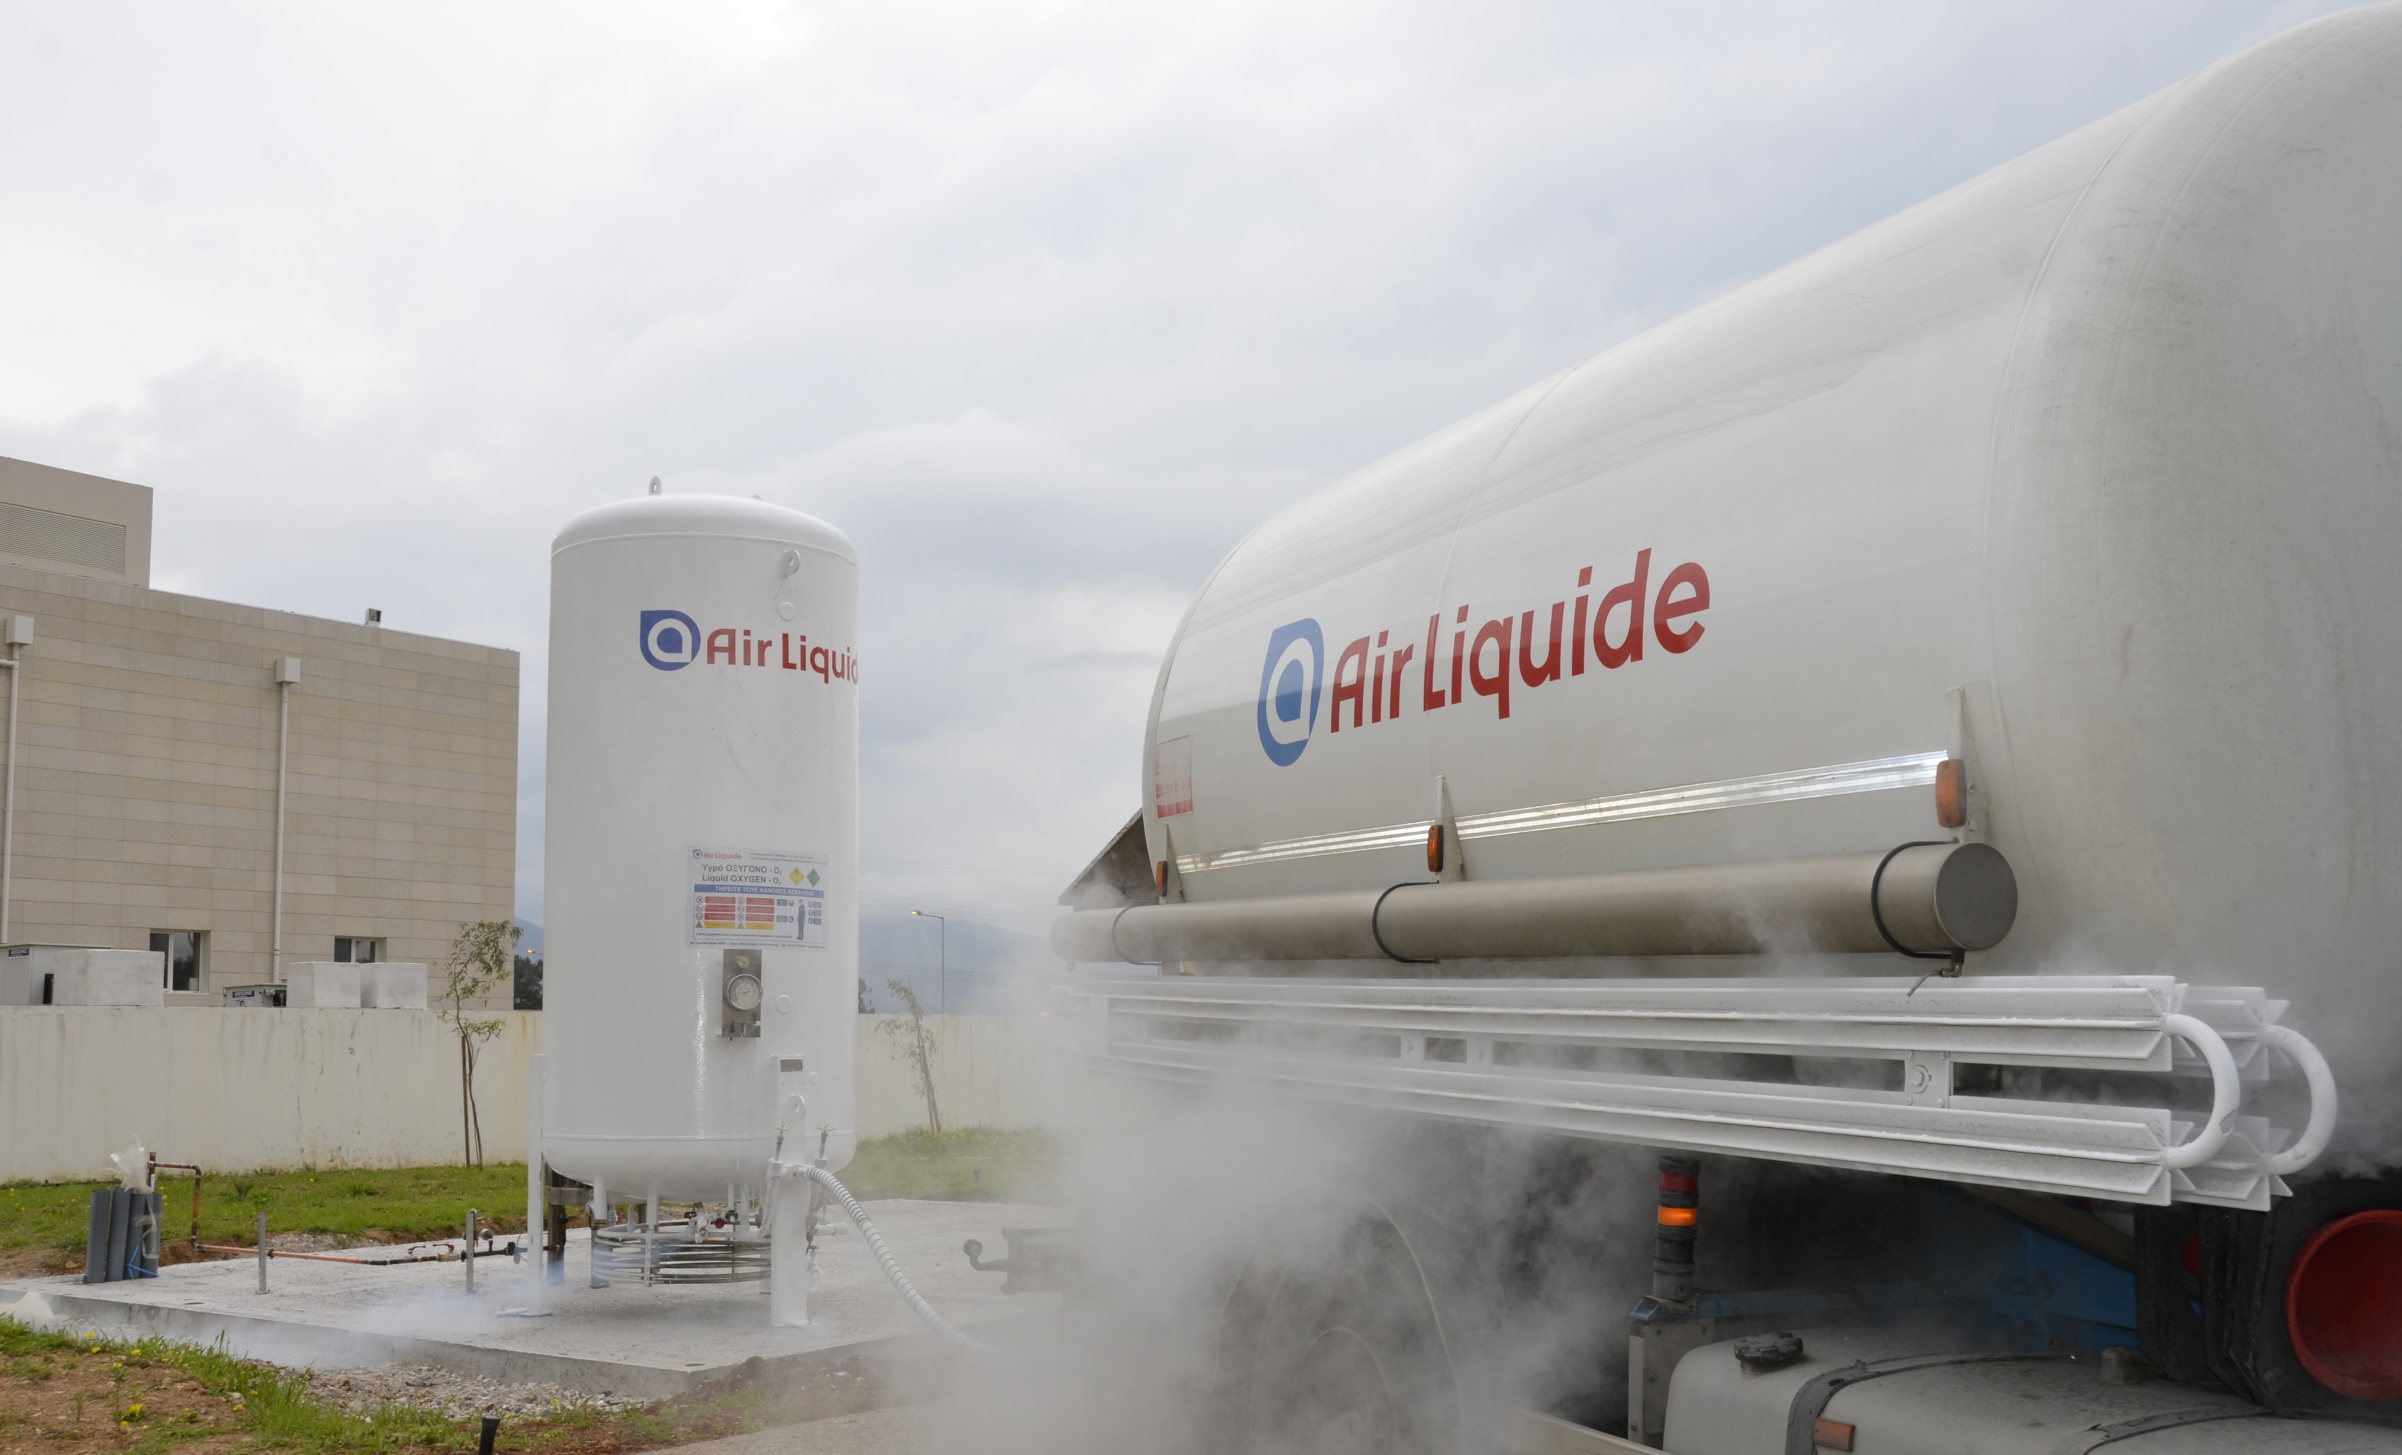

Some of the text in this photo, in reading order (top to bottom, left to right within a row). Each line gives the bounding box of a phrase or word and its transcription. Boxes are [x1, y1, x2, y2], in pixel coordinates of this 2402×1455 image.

[1330, 547, 1711, 734] Air Liquide
[706, 628, 772, 667] Air
[715, 852, 743, 860] Liquide
[702, 863, 724, 873] Υγρό
[702, 874, 729, 883] Liquid
[730, 875, 767, 884] OXYGEN
